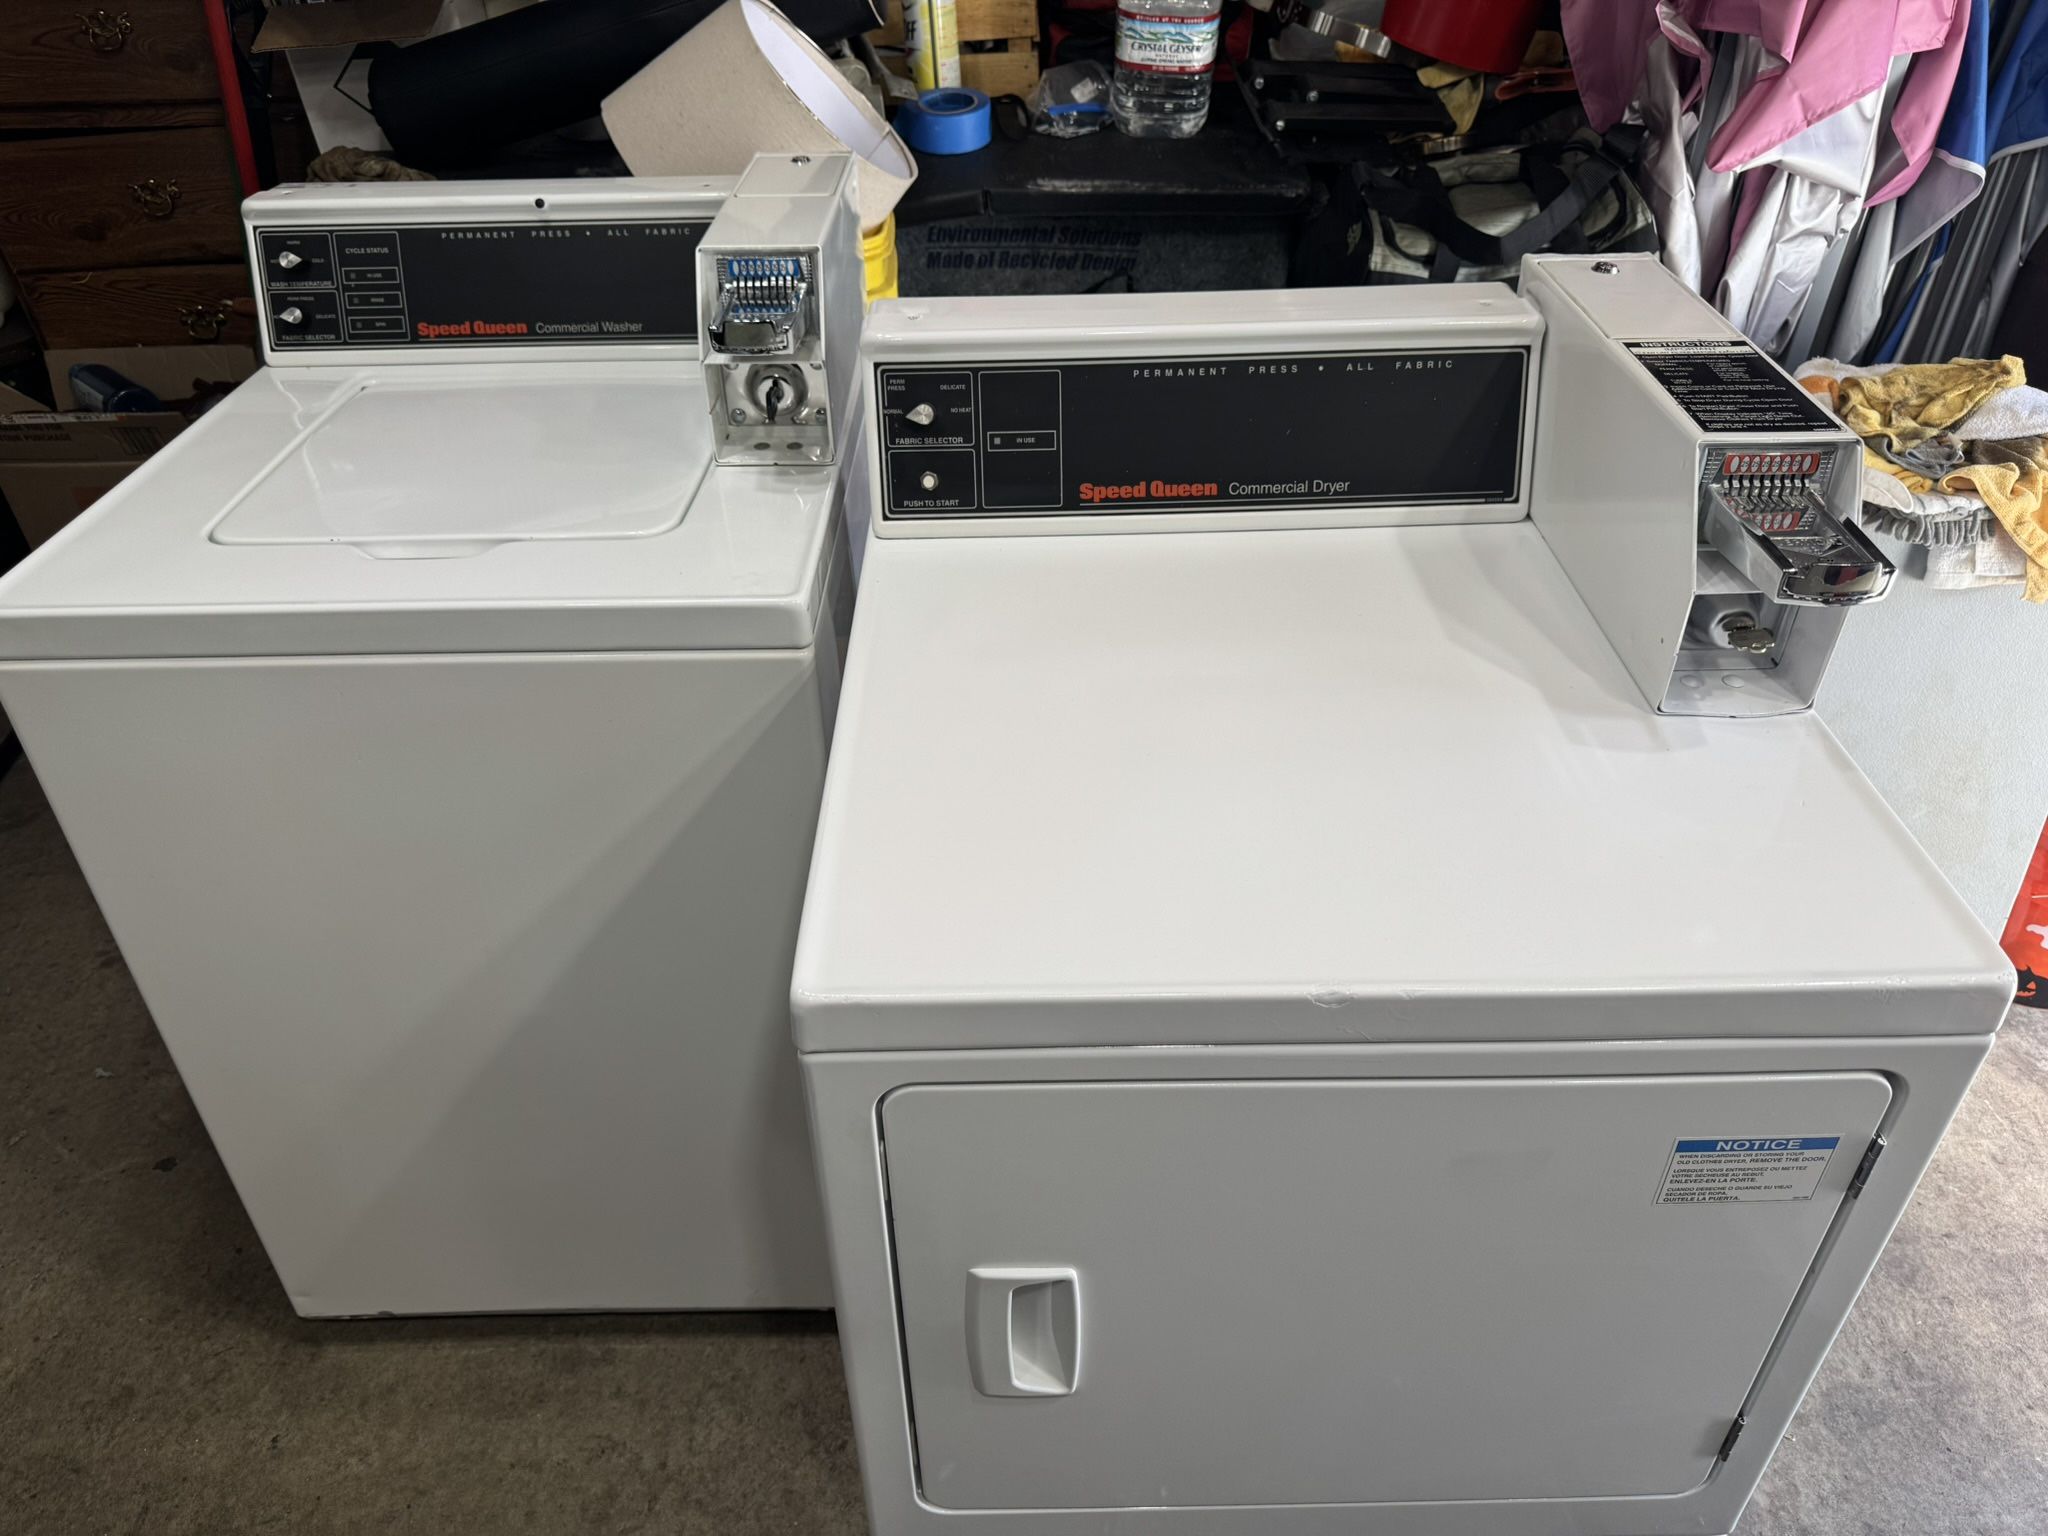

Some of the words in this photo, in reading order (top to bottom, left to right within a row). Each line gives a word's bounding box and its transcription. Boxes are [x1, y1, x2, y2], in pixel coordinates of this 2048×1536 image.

[1131, 41, 1168, 52] CRYSTAL
[441, 231, 516, 239] PERMANENT
[645, 227, 691, 235] FABRIC
[927, 226, 1055, 243] Environmental
[1057, 227, 1143, 245] Solutions
[927, 252, 975, 269] Made
[977, 252, 995, 268] of
[997, 252, 1077, 270] Recycled
[418, 322, 470, 337] Speed
[474, 320, 528, 335] Queen
[536, 322, 599, 333] Commercial
[602, 321, 643, 332] Washer
[1133, 368, 1228, 377] PERMANENT
[1249, 365, 1299, 374] PRESS
[1347, 362, 1374, 371] ALL
[1396, 360, 1454, 369] FABRIC
[1080, 482, 1146, 503] Speed
[1151, 480, 1218, 498] Queen
[1229, 481, 1309, 496] Commercial
[1313, 479, 1350, 496] Dryer
[1715, 1140, 1802, 1150] NOTICE
